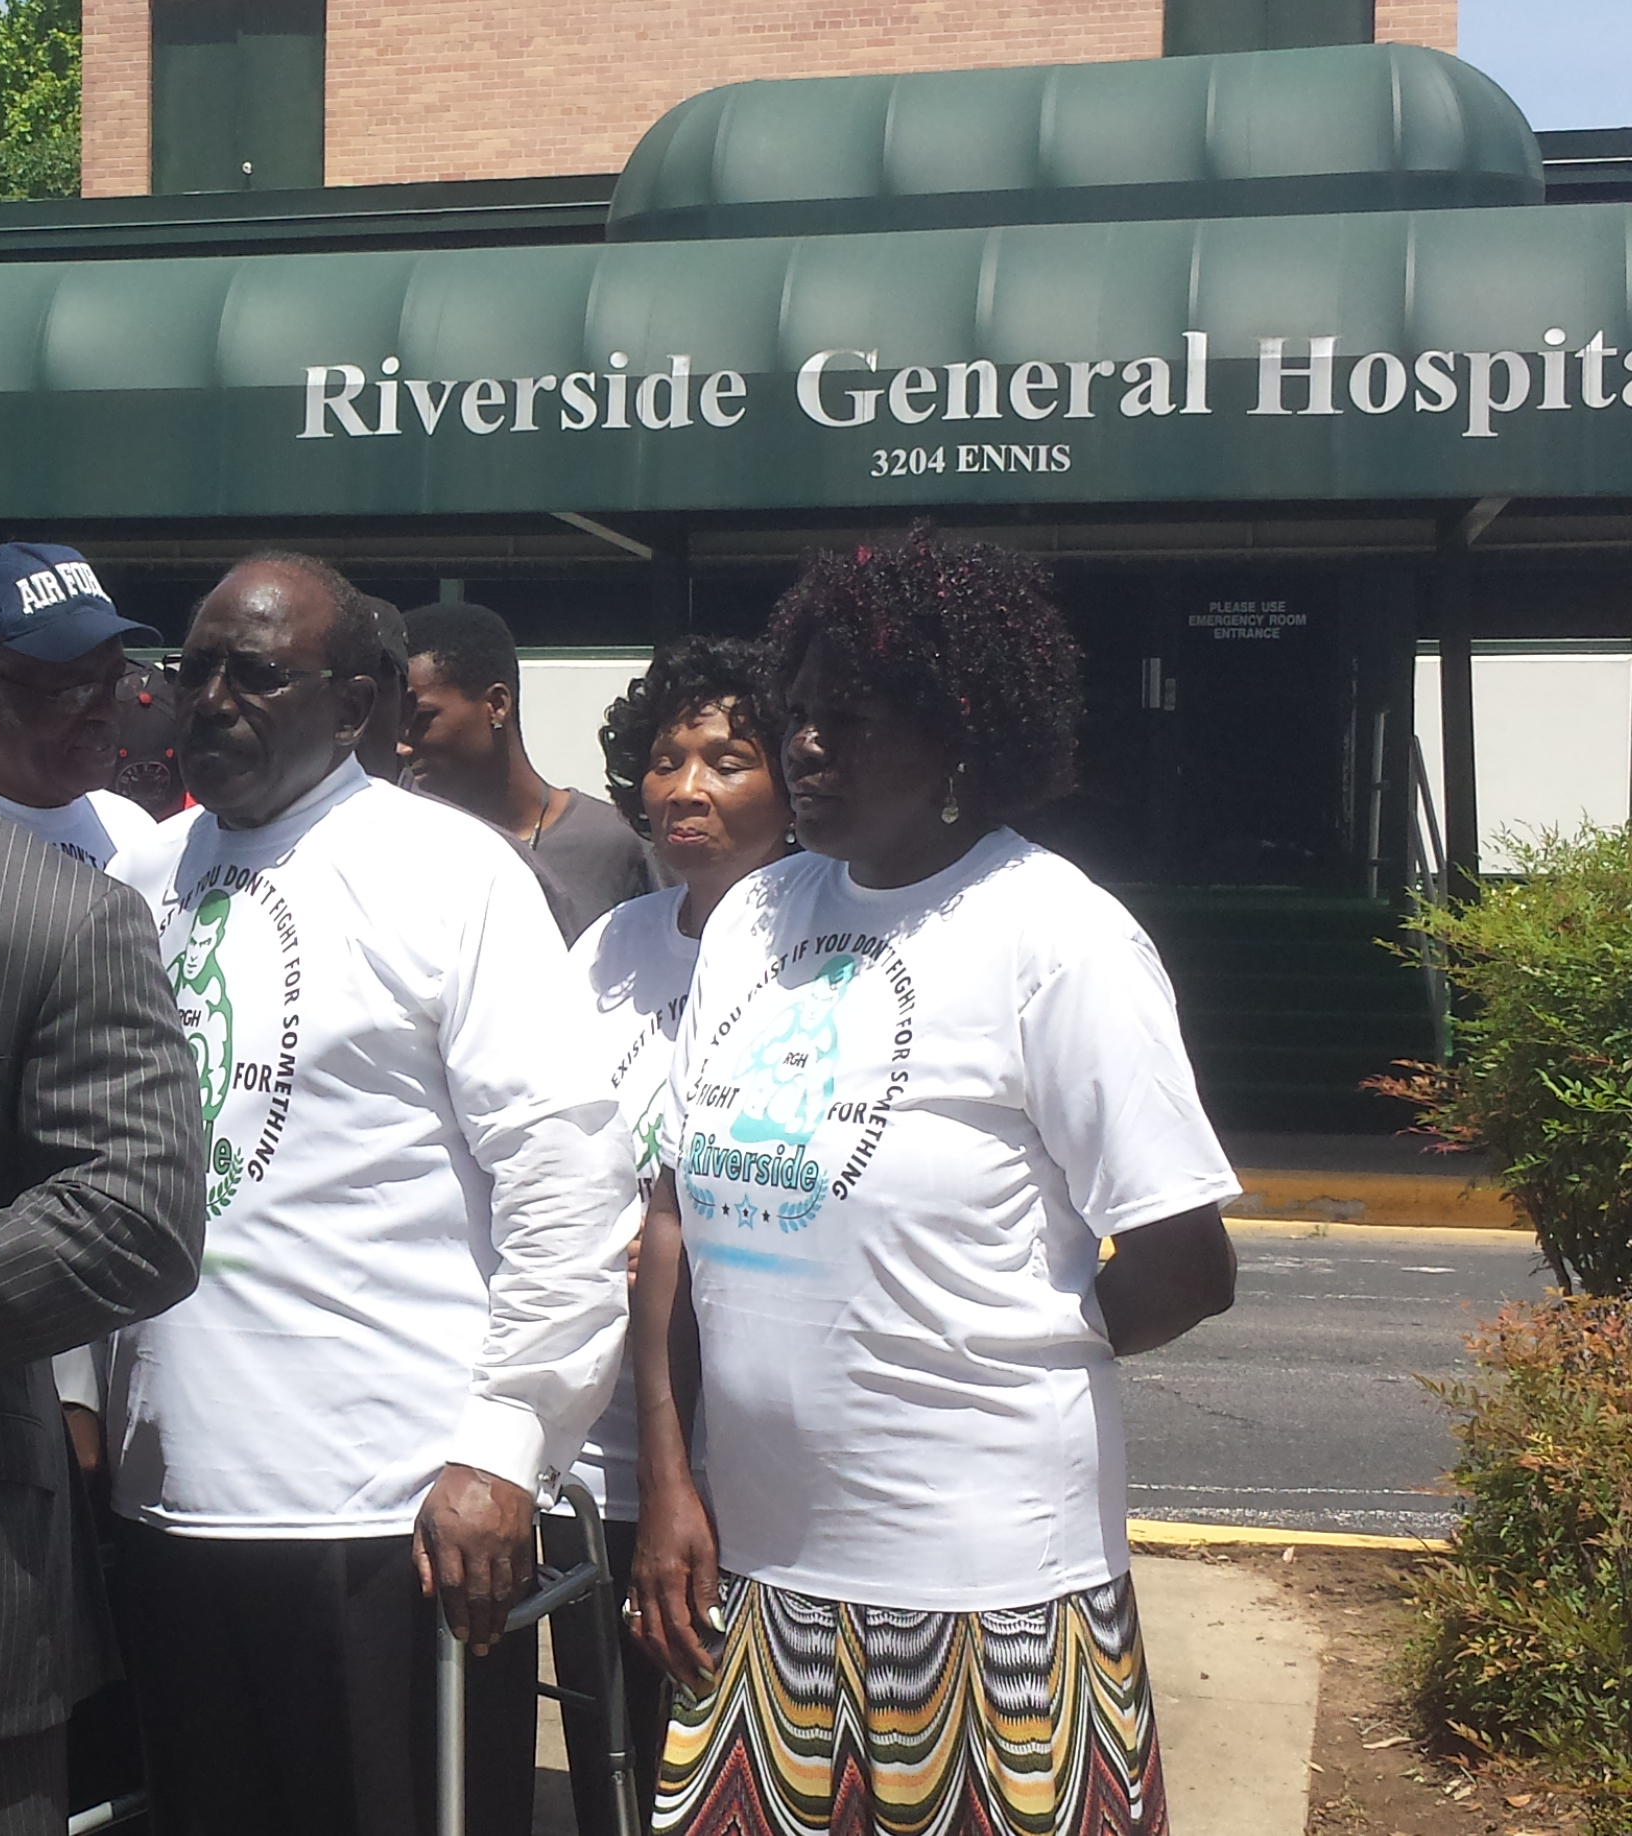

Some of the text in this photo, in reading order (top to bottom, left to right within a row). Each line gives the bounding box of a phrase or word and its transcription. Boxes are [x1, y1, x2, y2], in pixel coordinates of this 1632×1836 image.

[295, 327, 1632, 440] Riverside General Hospit
[870, 443, 1072, 478] 3204 ENNIS
[15, 562, 113, 615] AIR FOR
[1209, 601, 1286, 613] PLEASE USE
[1188, 614, 1307, 626] EMERGENCY ROOM
[1214, 627, 1280, 639] ENTRANCE
[223, 865, 277, 905] DON'T
[269, 897, 299, 953] FIGHT
[284, 957, 301, 1006] FOR
[710, 1006, 742, 1046] YOU
[792, 940, 809, 962] IF
[815, 933, 853, 955] YOU
[891, 1017, 913, 1062] FOR
[610, 994, 688, 1089] EXIST IF YO
[782, 1052, 809, 1068] RGH
[232, 1062, 272, 1093] FOR
[247, 1014, 300, 1182] SOMETHING
[827, 1101, 868, 1125] FOR
[688, 1131, 820, 1193] Riverside
